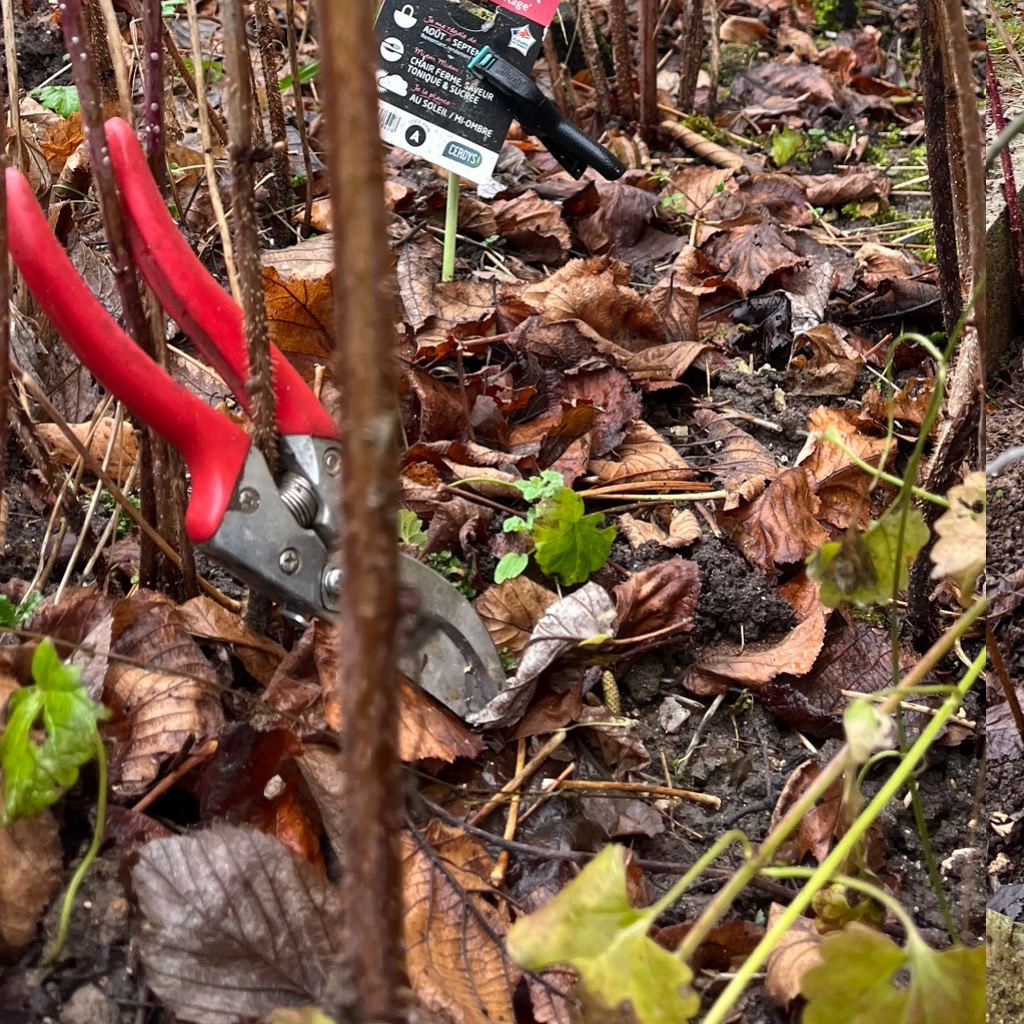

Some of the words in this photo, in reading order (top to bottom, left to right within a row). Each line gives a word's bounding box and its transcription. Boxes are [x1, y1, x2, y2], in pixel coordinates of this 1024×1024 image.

[422, 25, 447, 41] AOÛT
[407, 64, 442, 87] TONIQUE
[441, 81, 449, 90] &
[409, 56, 434, 74] CHAIR
[463, 81, 495, 101] SAVEUR
[409, 93, 421, 105] AU
[422, 98, 448, 117] SOLEIL
[453, 113, 494, 138] MI-OMBRE
[409, 129, 420, 143] A
[447, 144, 478, 165] CERDYS
